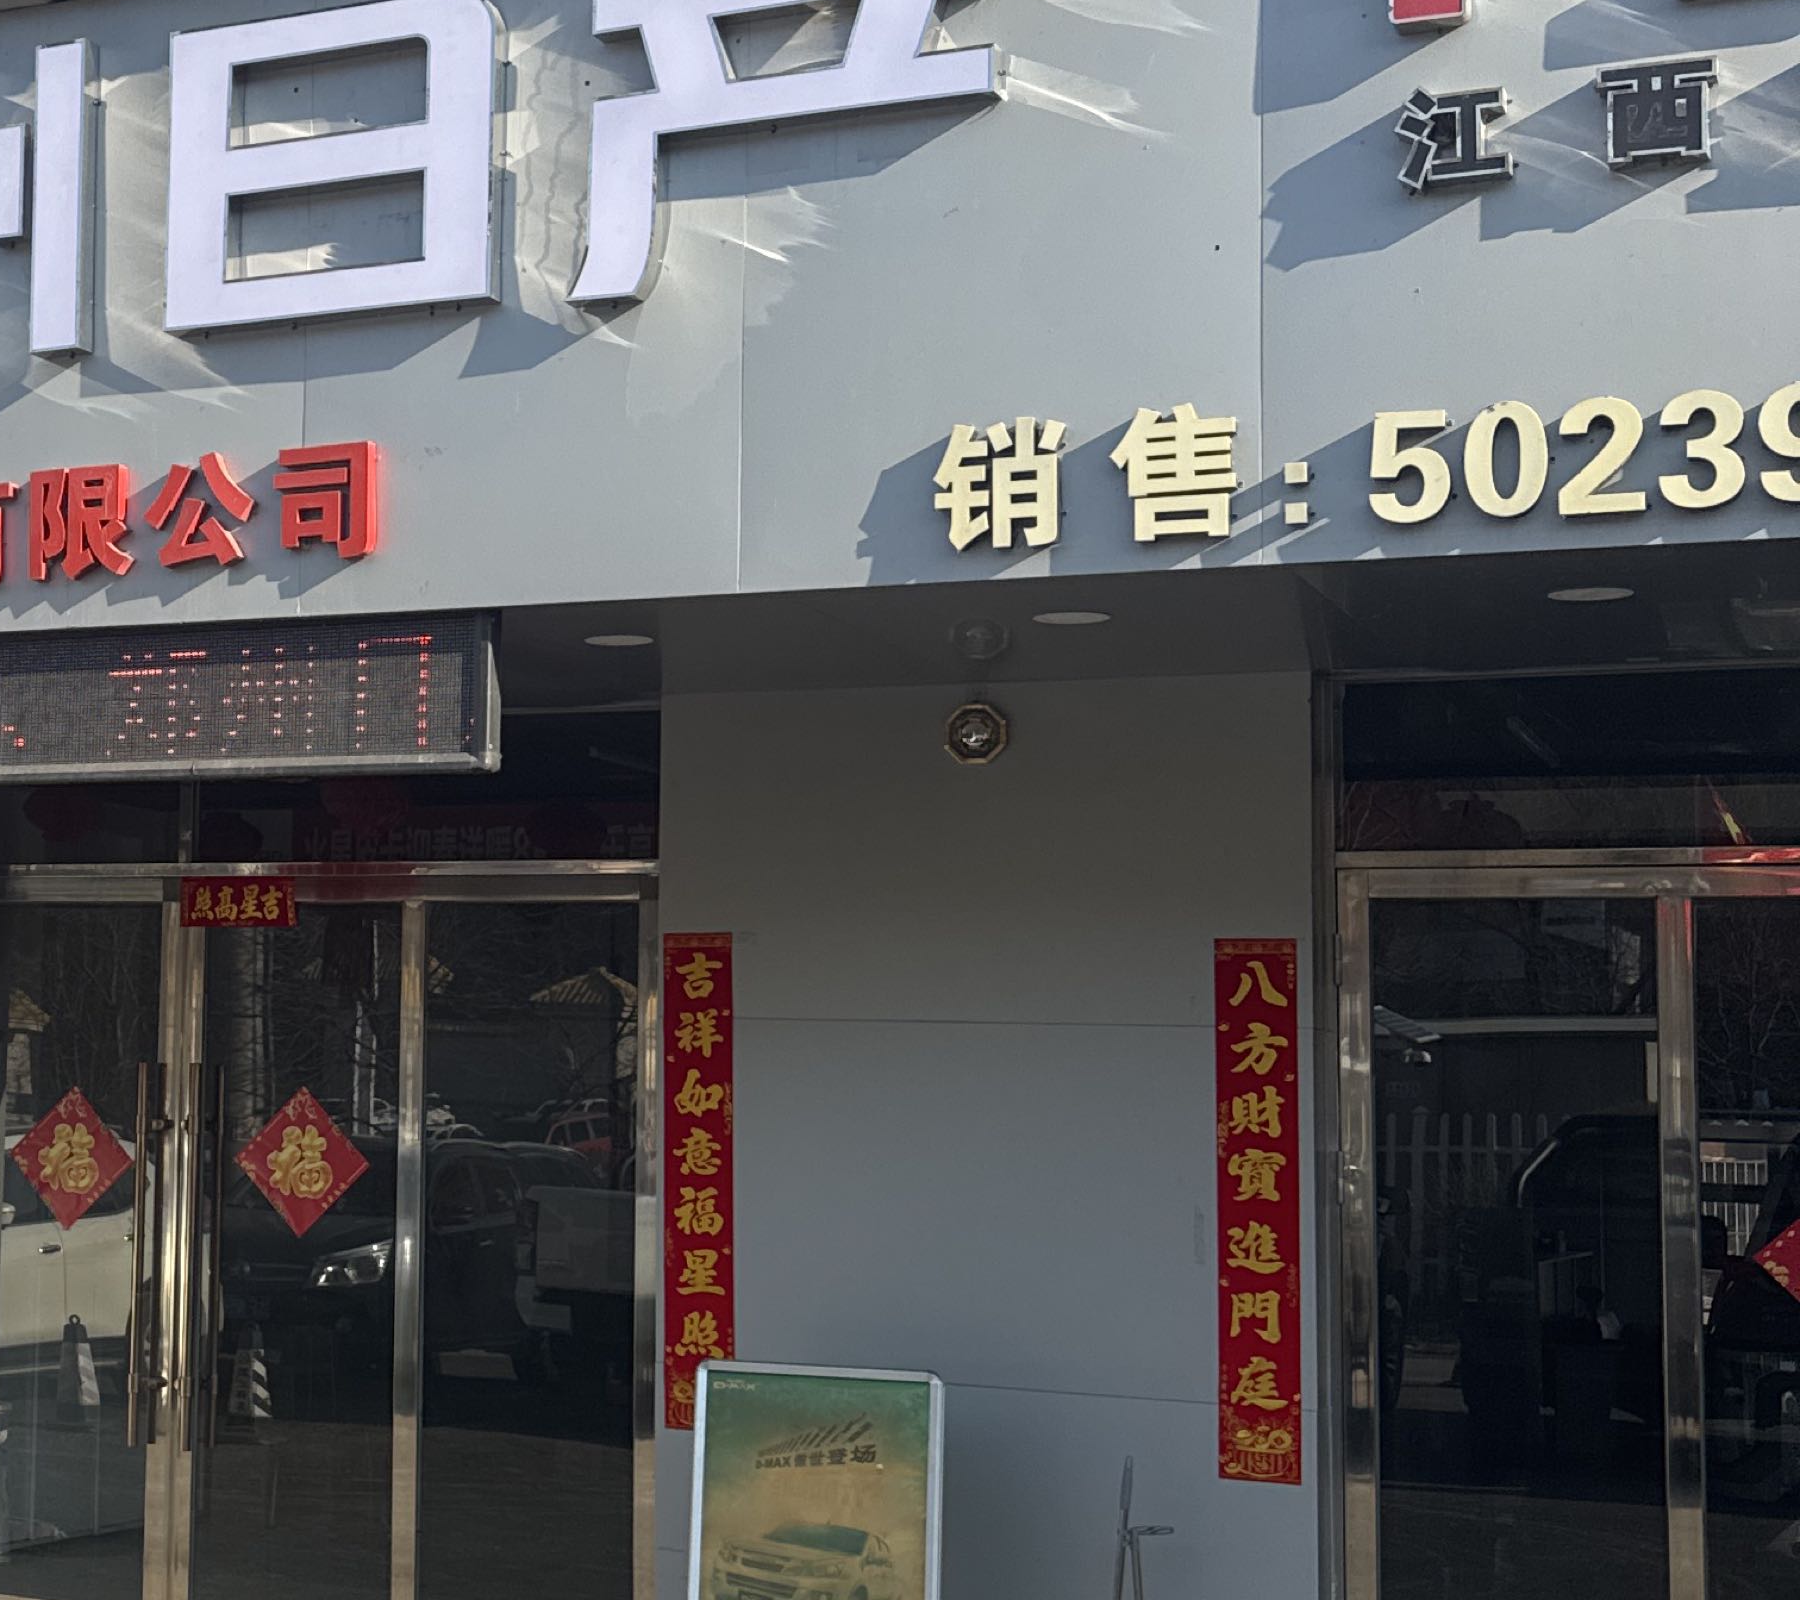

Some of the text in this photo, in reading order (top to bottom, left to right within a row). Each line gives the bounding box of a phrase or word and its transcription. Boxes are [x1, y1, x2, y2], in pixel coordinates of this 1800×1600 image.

[1395, 55, 1720, 196] 江西
[38, 1123, 99, 1194] 福
[266, 1125, 334, 1200] 福
[673, 952, 726, 1361] 吉祥如意福星照
